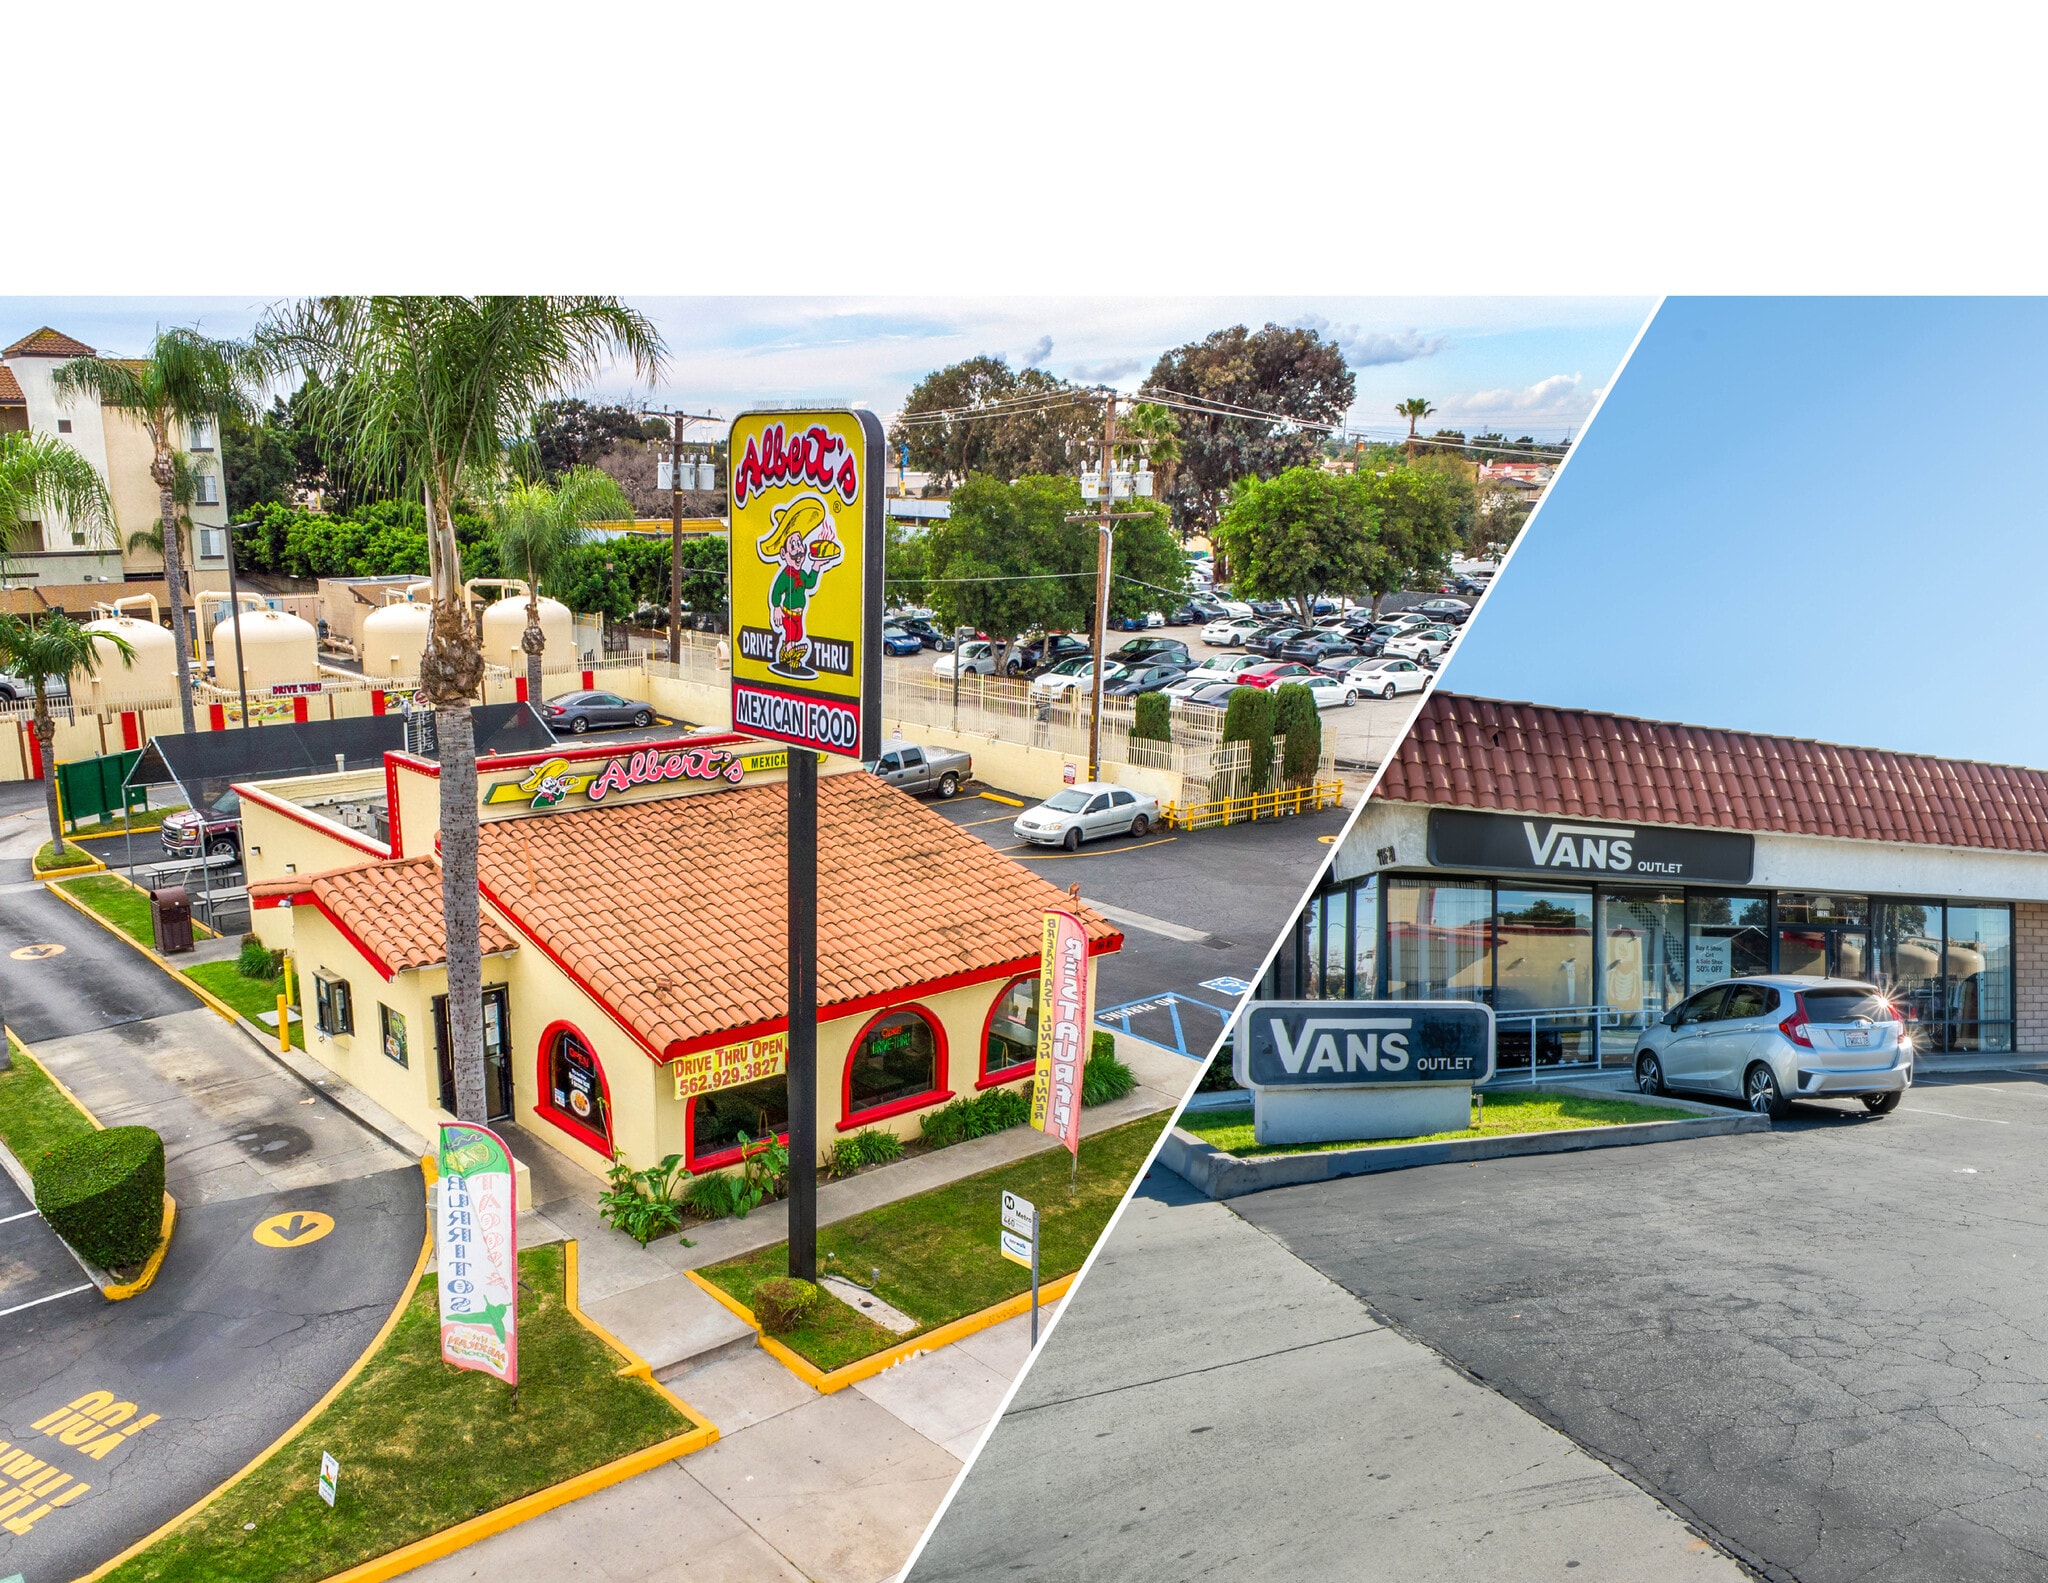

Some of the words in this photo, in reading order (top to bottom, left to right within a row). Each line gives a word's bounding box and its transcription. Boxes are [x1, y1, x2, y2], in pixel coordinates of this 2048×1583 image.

[734, 422, 859, 507] Albert's
[741, 630, 774, 660] DRIVE
[814, 641, 849, 672] THRU
[272, 684, 298, 695] DRIVE
[300, 682, 322, 692] THRU
[736, 689, 806, 738] MEXICAN
[808, 703, 858, 749] FOOD
[586, 747, 745, 801] Albert's
[751, 753, 788, 770] MEXICA
[1523, 822, 1635, 871] VANS
[1638, 861, 1683, 874] OUTLET
[1098, 1003, 1157, 1022] PARKING
[675, 1055, 712, 1078] DRIVE
[715, 1046, 749, 1068] THRU
[752, 1037, 783, 1059] OPEN
[1270, 1018, 1413, 1073] VANS
[1417, 1057, 1473, 1071] OUTLET
[680, 1056, 779, 1096] 562.929.3827
[1015, 1209, 1032, 1224] Metro
[30, 1390, 162, 1461] YOU
